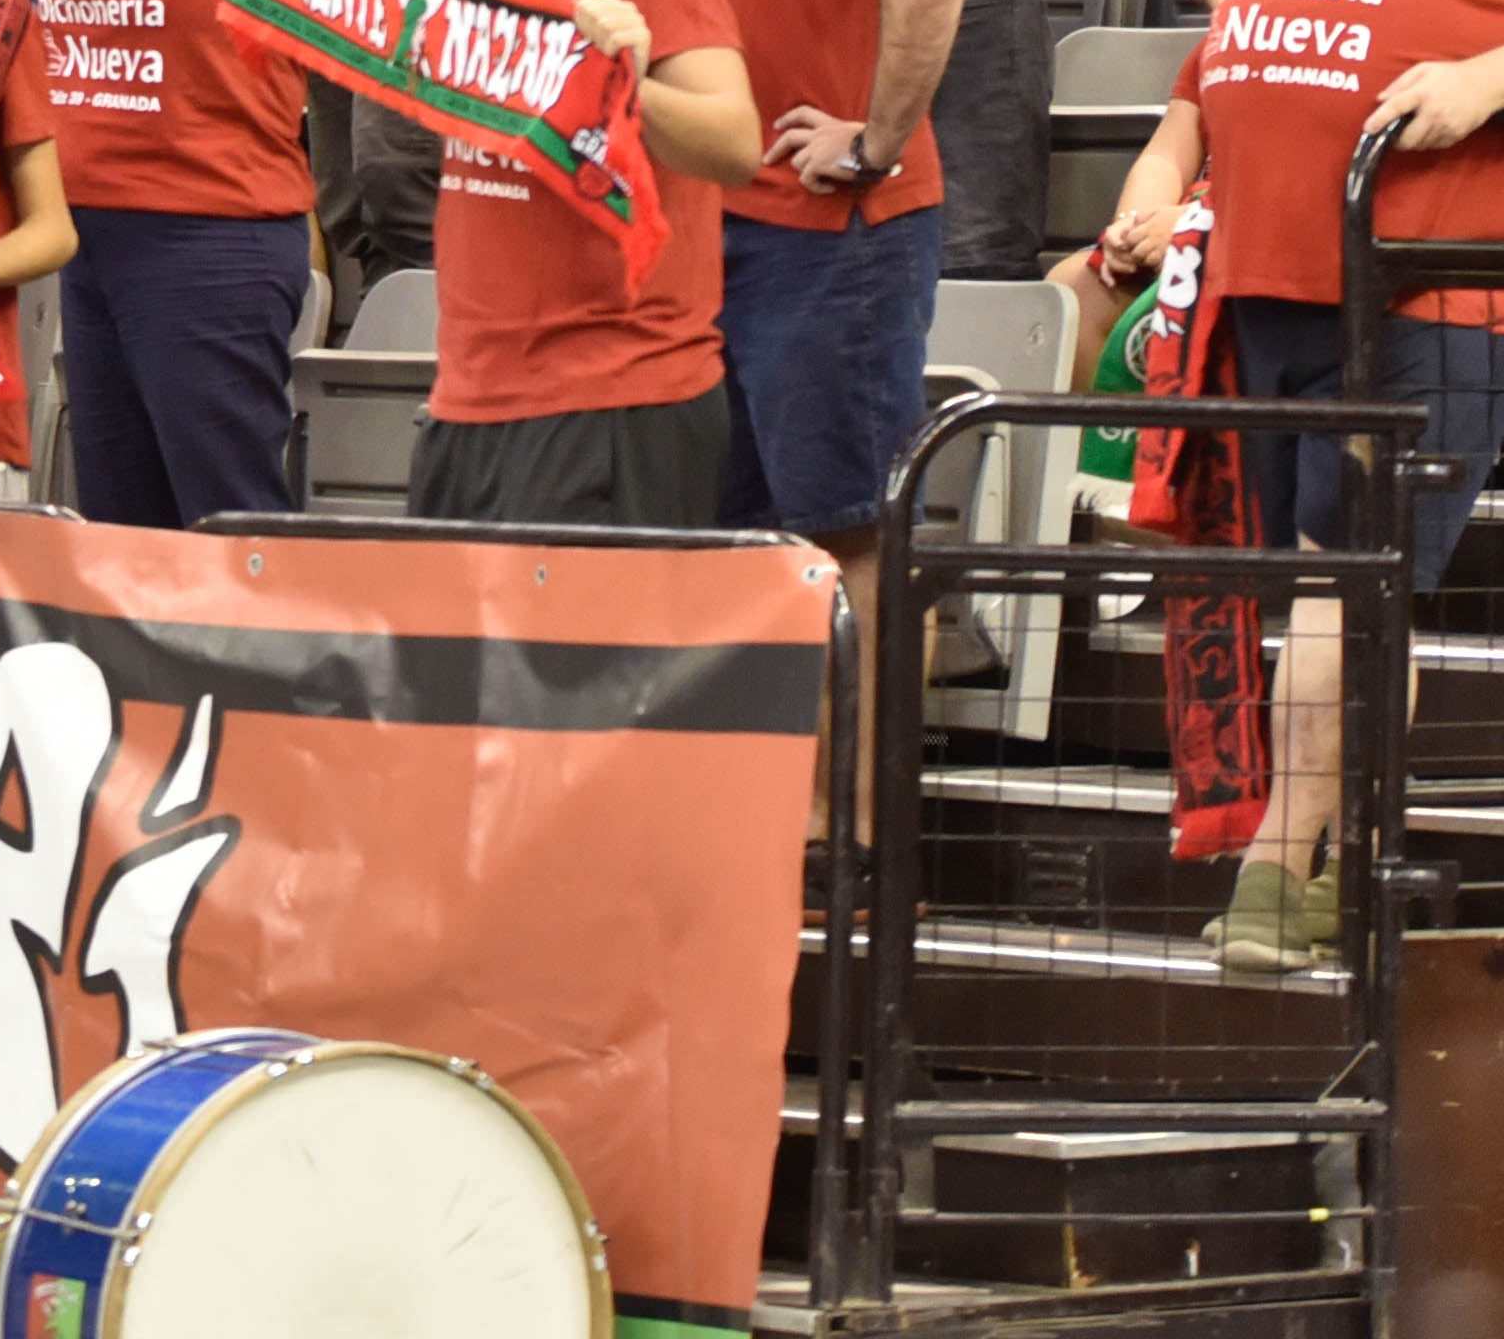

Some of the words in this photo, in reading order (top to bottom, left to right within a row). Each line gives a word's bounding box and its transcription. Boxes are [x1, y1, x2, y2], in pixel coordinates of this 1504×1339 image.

[1221, 5, 1371, 62] Nueva
[64, 34, 165, 83] Nueva
[1262, 63, 1360, 94] GRANADA
[91, 91, 162, 112] GRANADA
